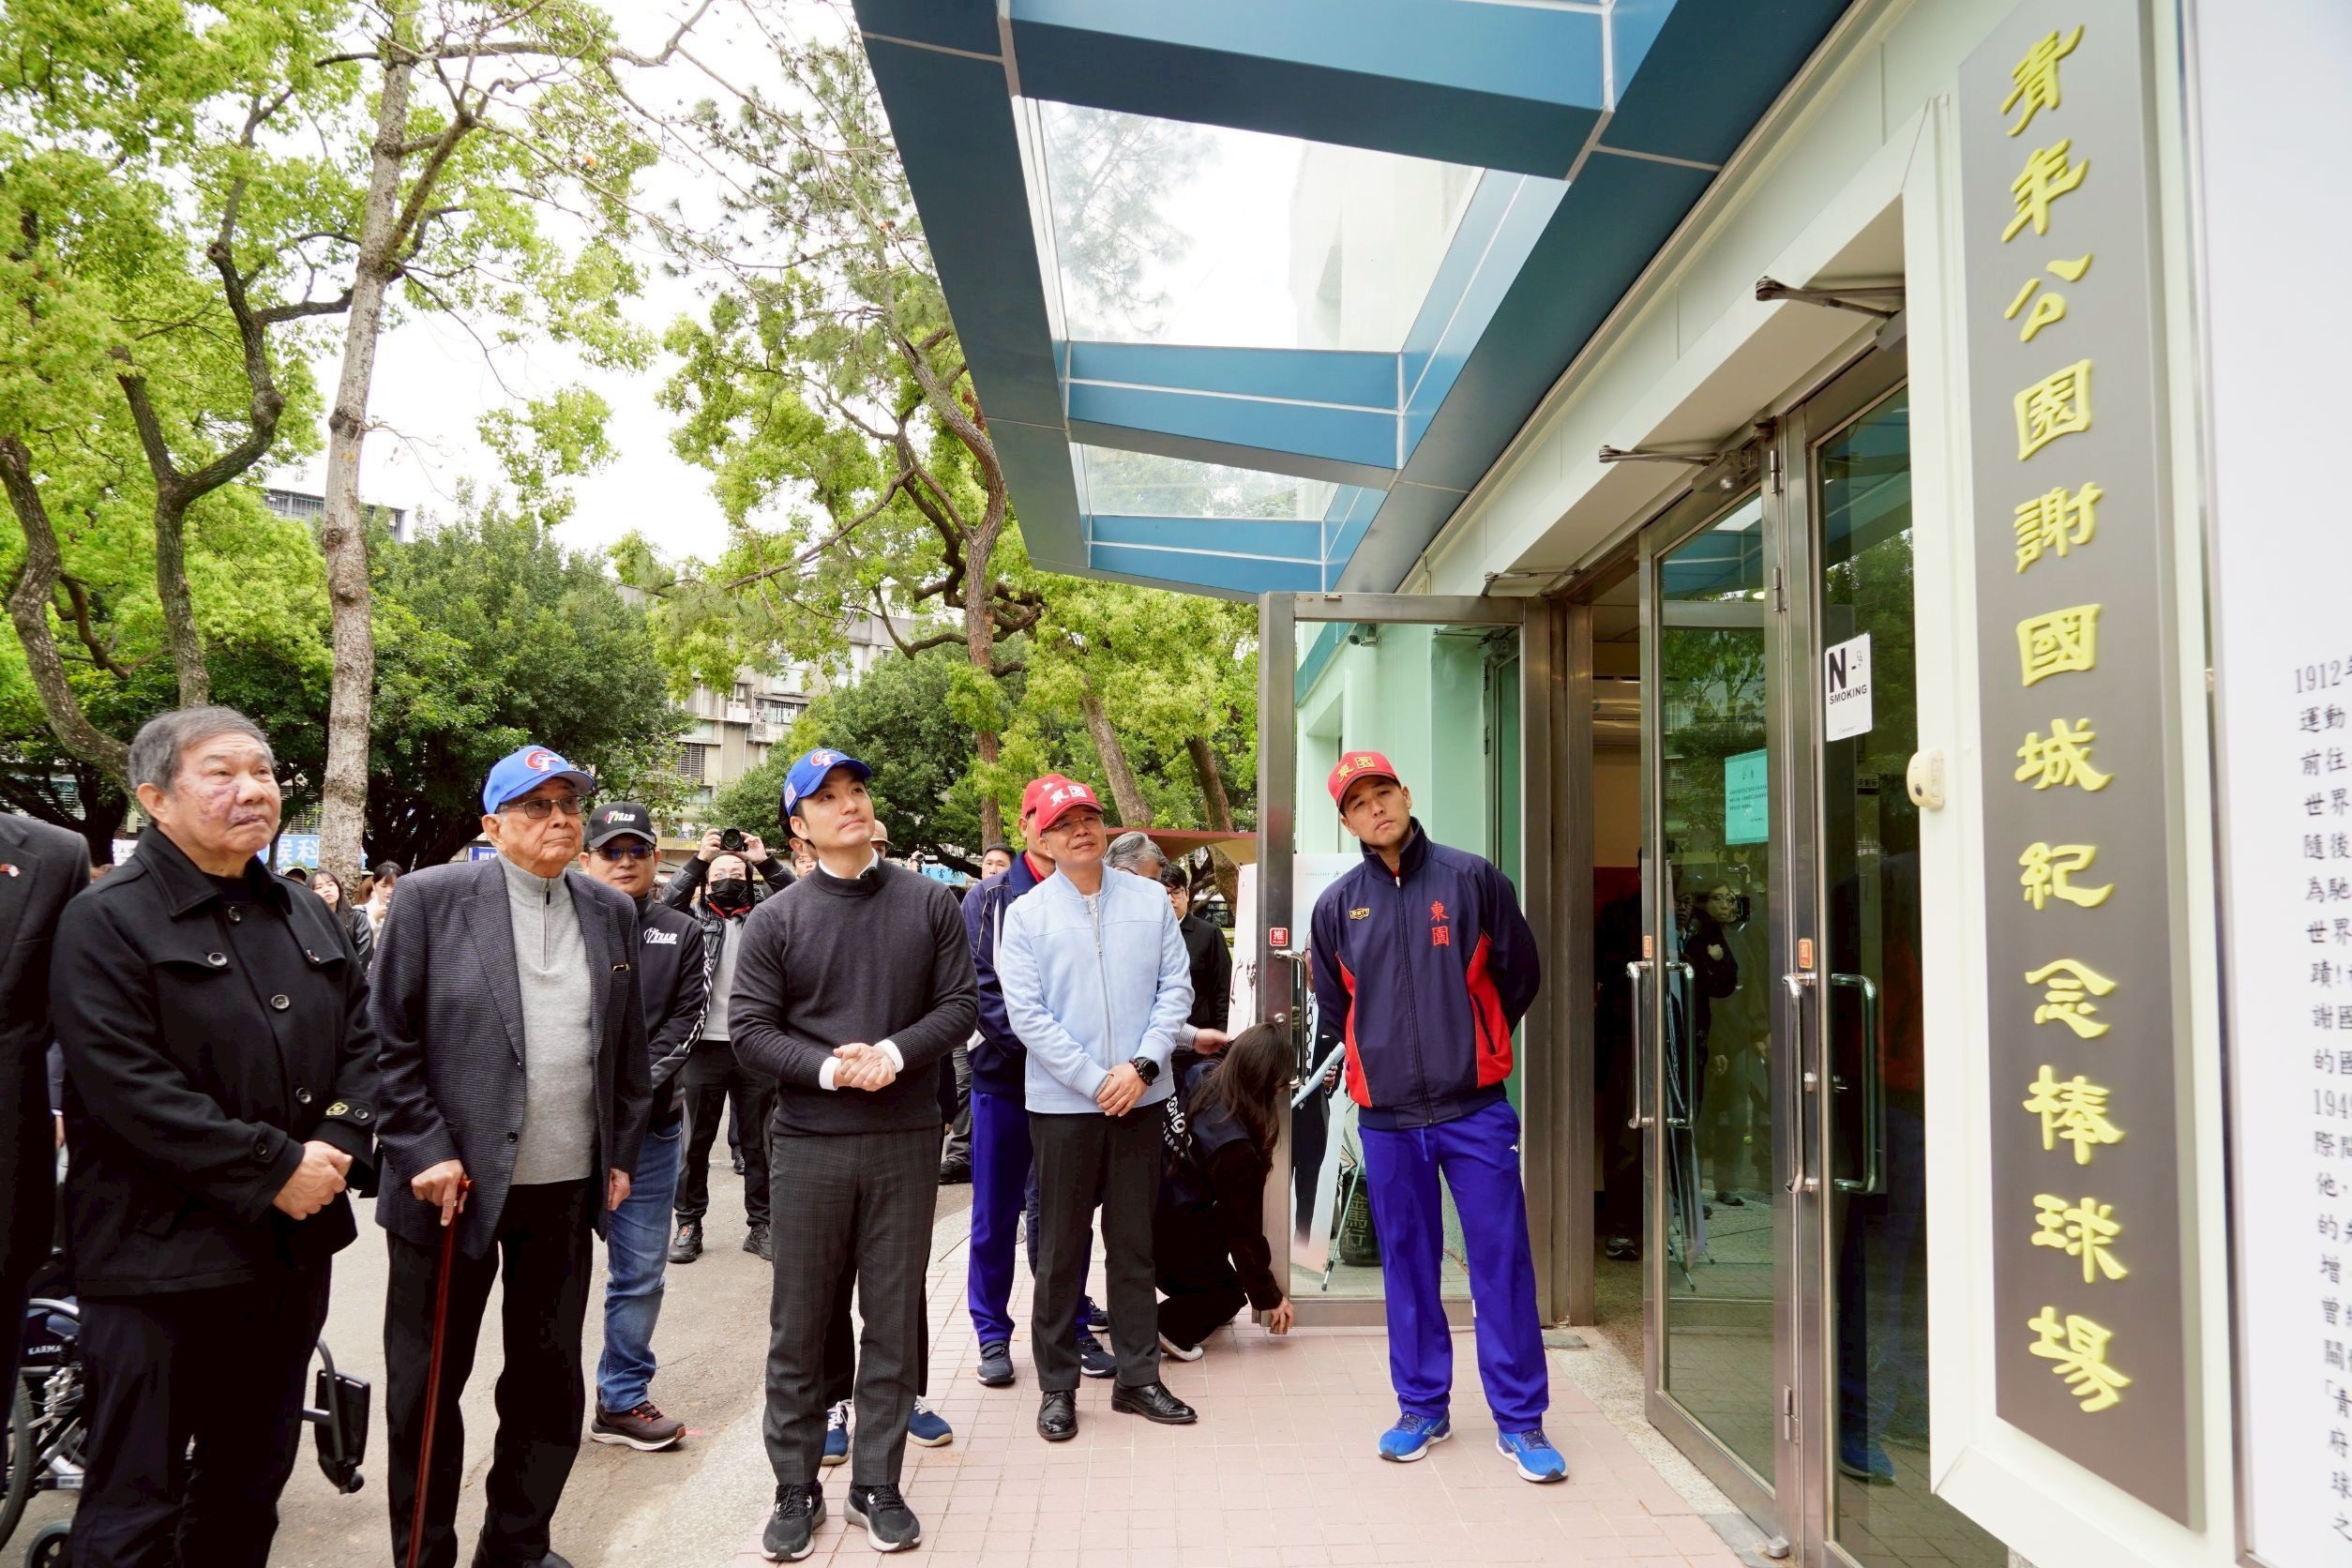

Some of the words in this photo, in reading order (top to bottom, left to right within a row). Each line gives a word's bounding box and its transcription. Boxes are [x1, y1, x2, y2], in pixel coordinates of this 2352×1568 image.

[1830, 685, 1867, 704] SMOKING
[2000, 23, 2133, 1413] 青年公園謝國城紀念棒球場
[2299, 704, 2345, 732] 運動
[1430, 900, 1450, 947] 東園
[2314, 1089, 2352, 1119] 194
